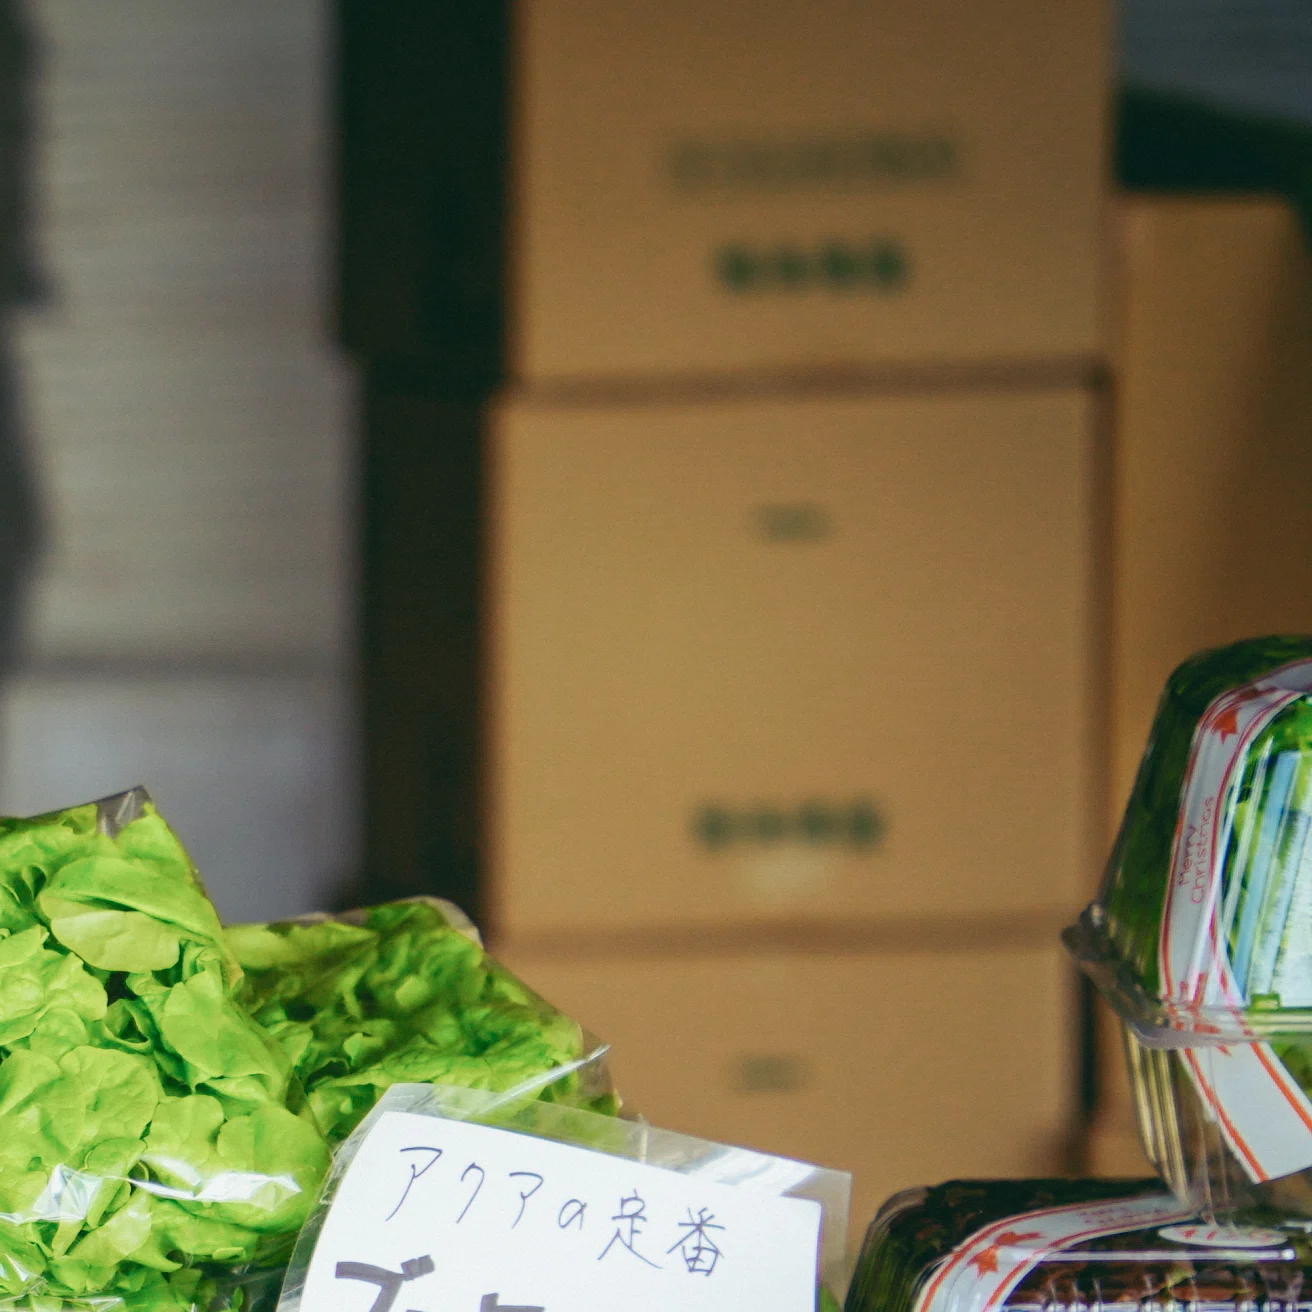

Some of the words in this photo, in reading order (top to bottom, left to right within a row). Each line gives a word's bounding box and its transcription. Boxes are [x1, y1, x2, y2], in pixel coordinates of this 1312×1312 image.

[1178, 825, 1196, 886] Merry
[1191, 797, 1214, 904] Christmas
[385, 1145, 726, 1277] アクアの定番
